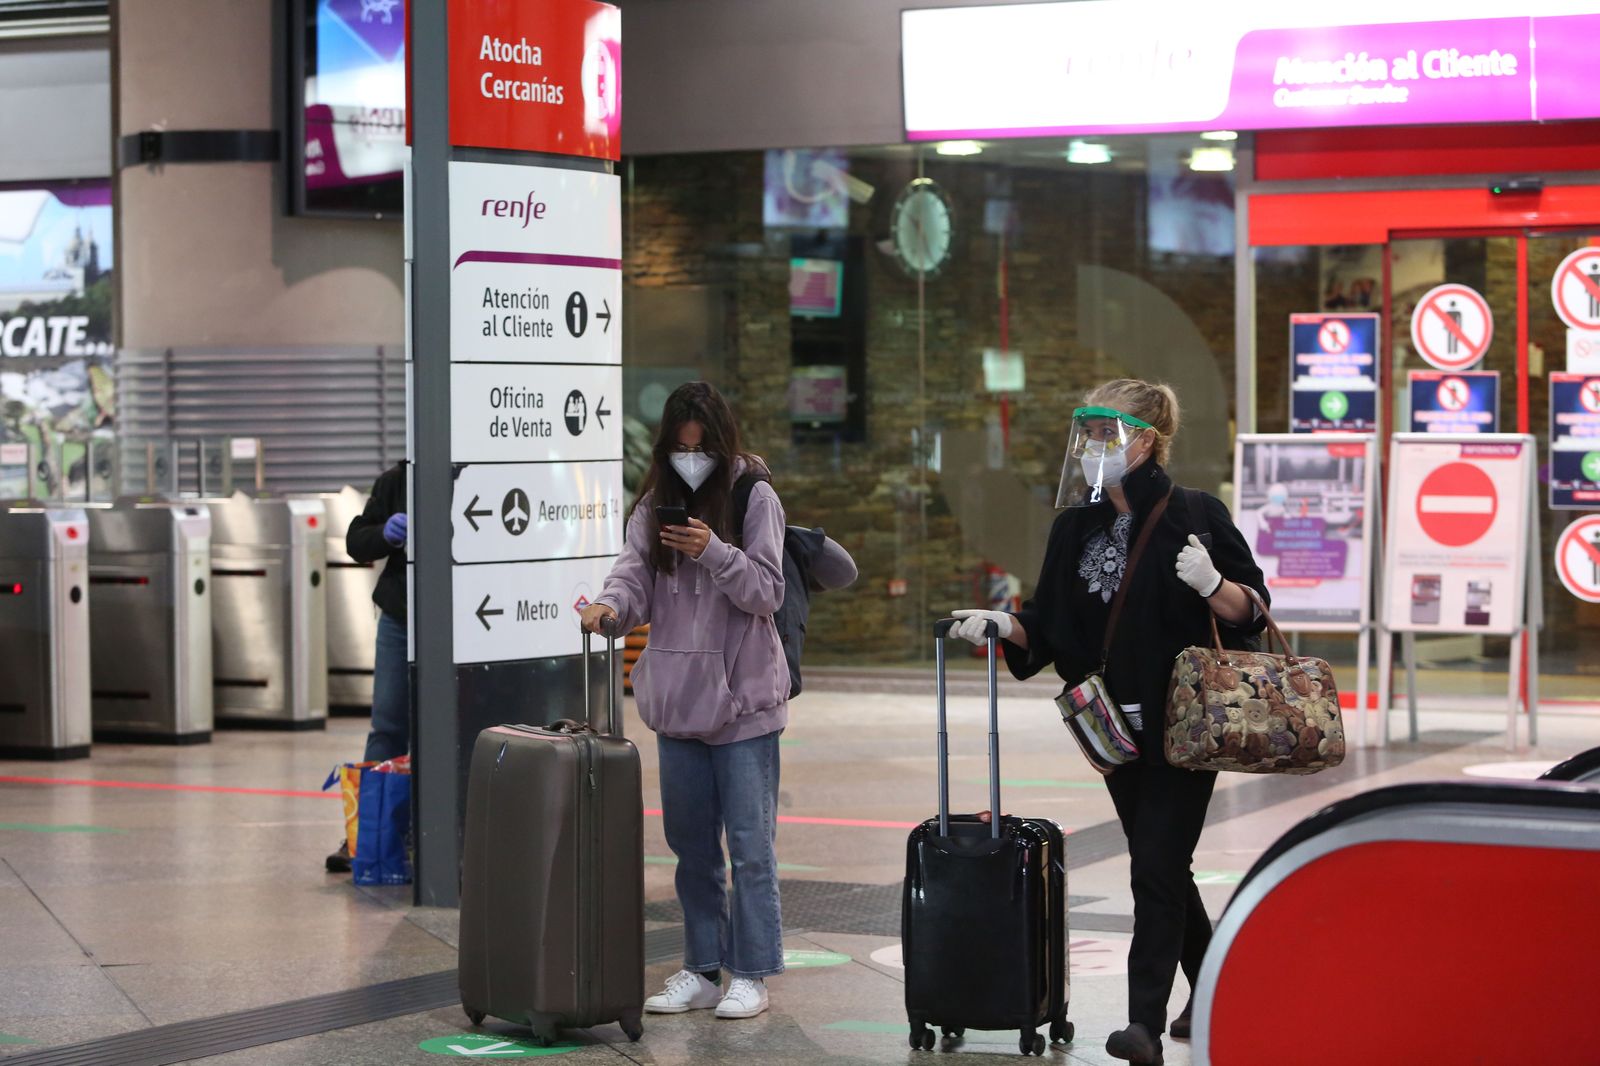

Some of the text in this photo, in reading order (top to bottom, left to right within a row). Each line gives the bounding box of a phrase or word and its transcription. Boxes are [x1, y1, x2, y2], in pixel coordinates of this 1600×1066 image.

[479, 34, 542, 66] Atocha
[1391, 49, 1419, 80] al
[1422, 47, 1518, 79] Cliente
[480, 71, 564, 105] Cercanías
[481, 190, 546, 229] renfe
[482, 287, 549, 310] Atención
[482, 315, 554, 338] al Cliente
[489, 386, 544, 409] Oficina
[489, 415, 552, 438] de Venta
[537, 500, 607, 526] Aeropuerto
[516, 599, 559, 622] Metro
